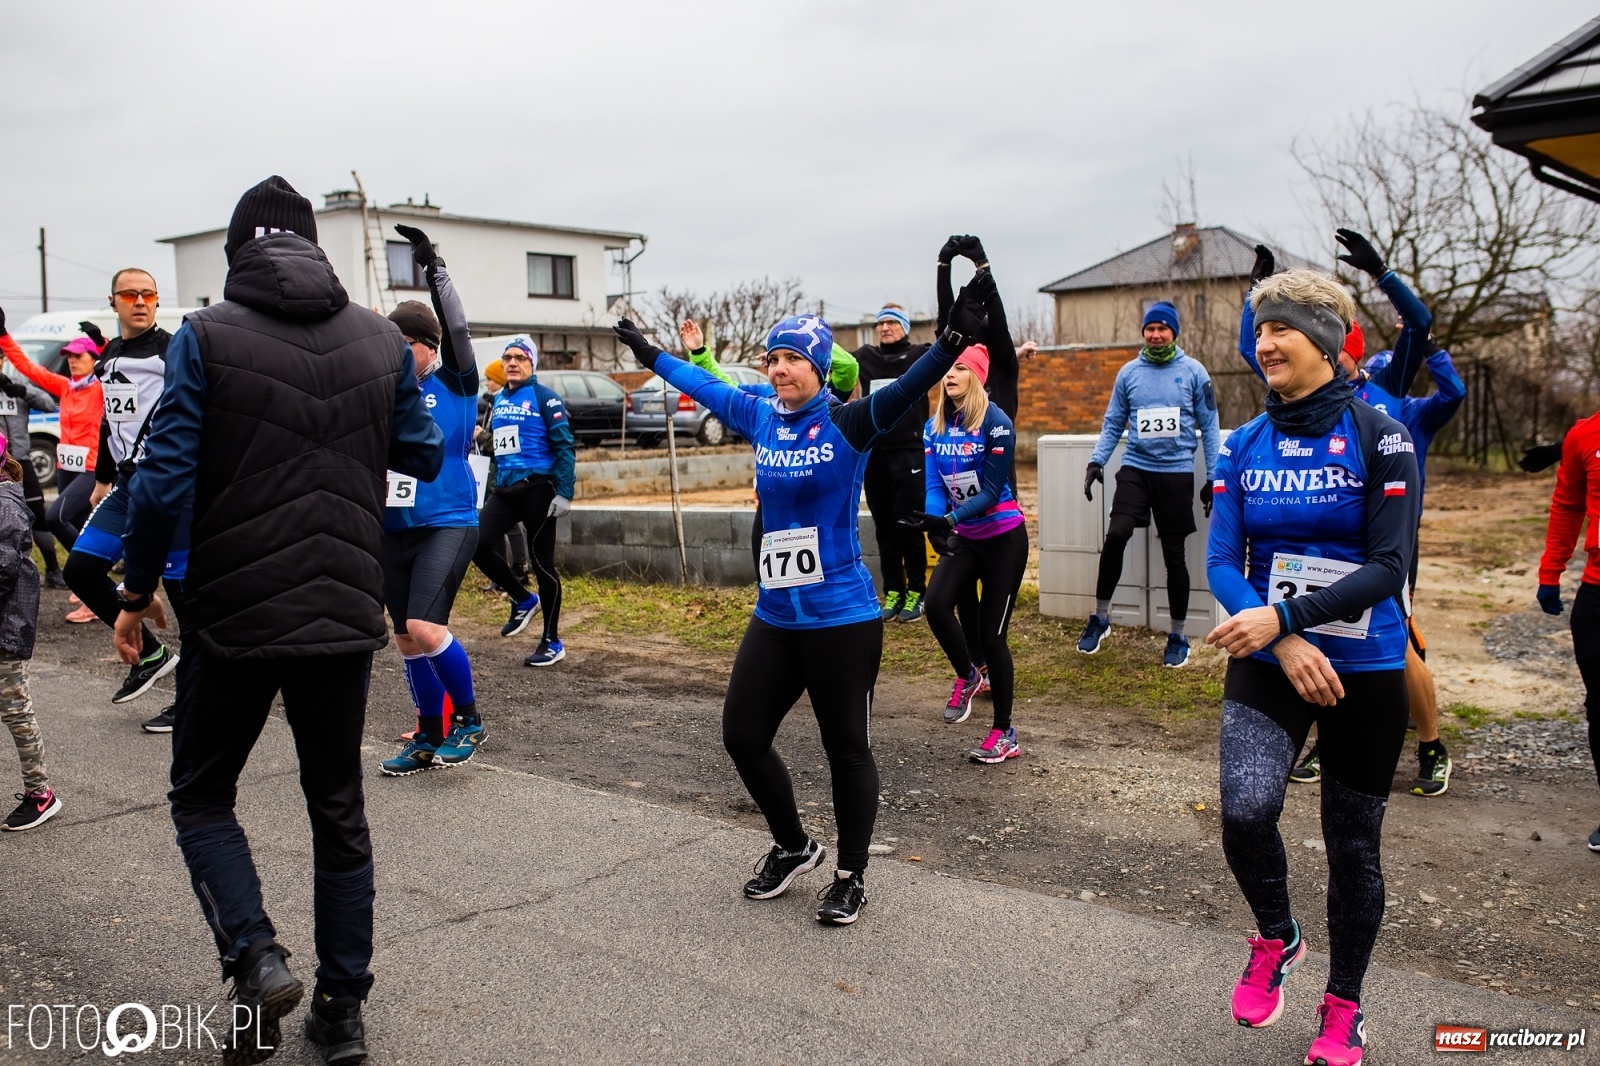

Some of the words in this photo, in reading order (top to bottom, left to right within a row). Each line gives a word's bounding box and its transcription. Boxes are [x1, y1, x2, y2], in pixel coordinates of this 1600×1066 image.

[105, 397, 136, 414] 324
[1140, 417, 1177, 433] 233
[494, 435, 516, 451] 341
[59, 453, 84, 467] 360
[789, 469, 813, 478] TEAM
[1305, 493, 1338, 505] TEAM
[762, 548, 816, 578] 170
